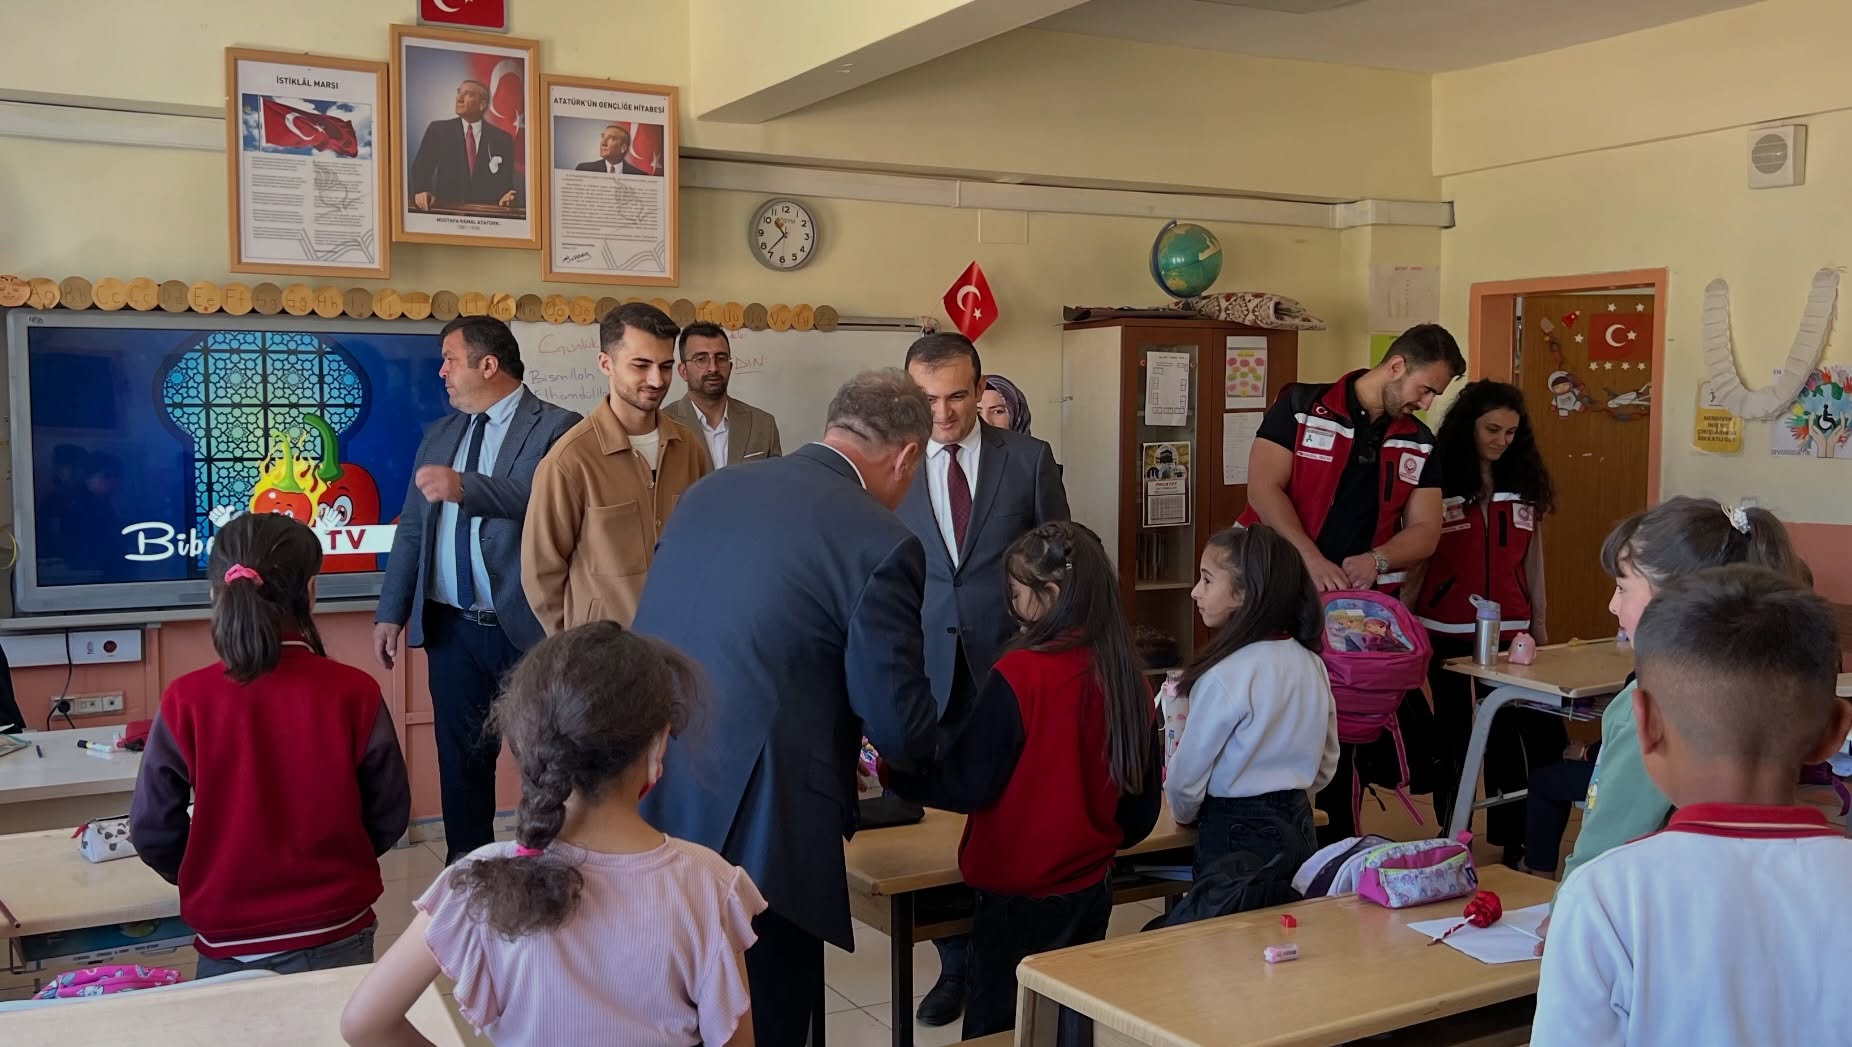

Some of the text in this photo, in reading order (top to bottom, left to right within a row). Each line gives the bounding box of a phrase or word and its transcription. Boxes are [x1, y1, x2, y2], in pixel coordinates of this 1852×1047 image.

[771, 207, 777, 217] 11
[782, 205, 790, 214] 12
[763, 216, 772, 225] 10
[801, 219, 807, 228] 2
[757, 228, 764, 237] 9
[804, 232, 810, 241] 3
[760, 242, 767, 250] 8
[799, 245, 805, 253] 4
[779, 255, 786, 264] 6
[791, 252, 798, 262] 5
[328, 528, 366, 550] TV
